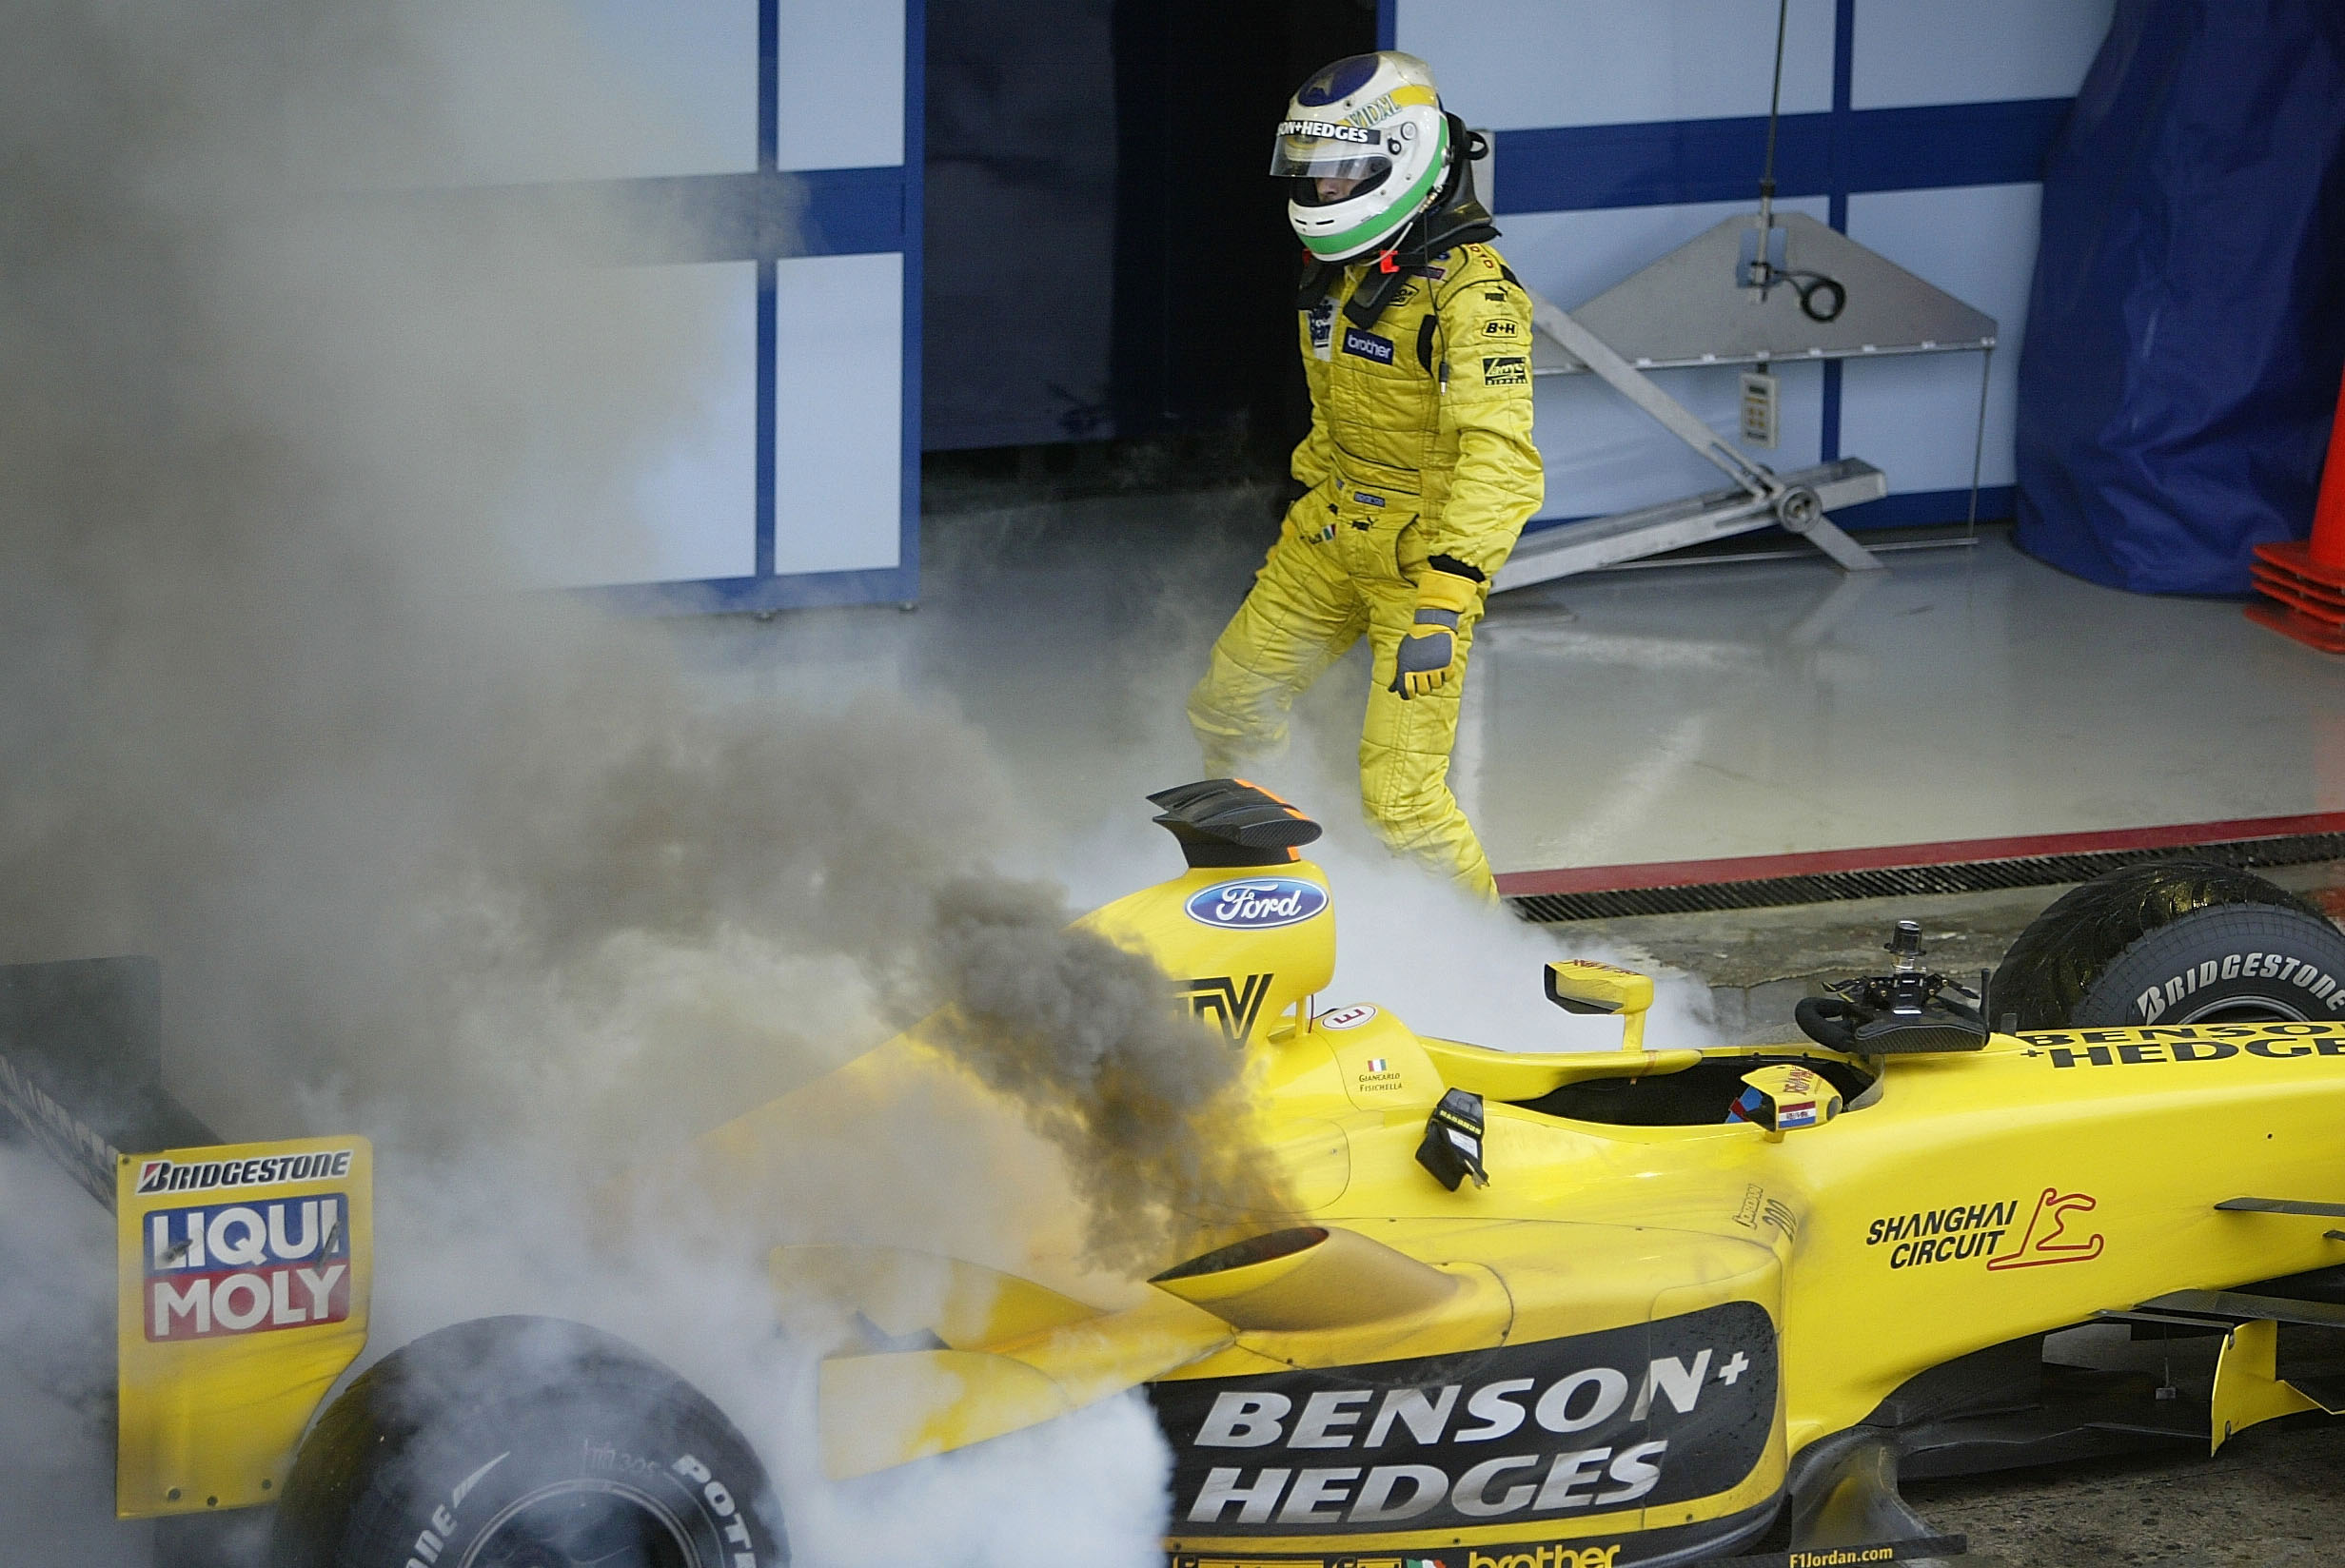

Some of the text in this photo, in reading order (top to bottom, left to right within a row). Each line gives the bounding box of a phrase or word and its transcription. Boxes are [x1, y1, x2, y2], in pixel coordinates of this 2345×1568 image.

[1348, 334, 1391, 359] brother
[1486, 323, 1515, 334] B+H
[1216, 884, 1301, 920] Ford
[2137, 952, 2345, 1026] BRIDGESTONE
[1358, 1072, 1401, 1083] GIANCARLO
[1359, 1082, 1403, 1092] FISICHELLA
[139, 1151, 351, 1192] BRIDGESTONE
[153, 1200, 340, 1270] LIQUI
[1866, 1200, 2018, 1245] SHANGHAI
[1890, 1230, 2005, 1269] CIRCUIT
[153, 1264, 347, 1337] MOLY
[1186, 1440, 1669, 1523] HEDGES
[1789, 1548, 1893, 1568] F1Jordan.com
